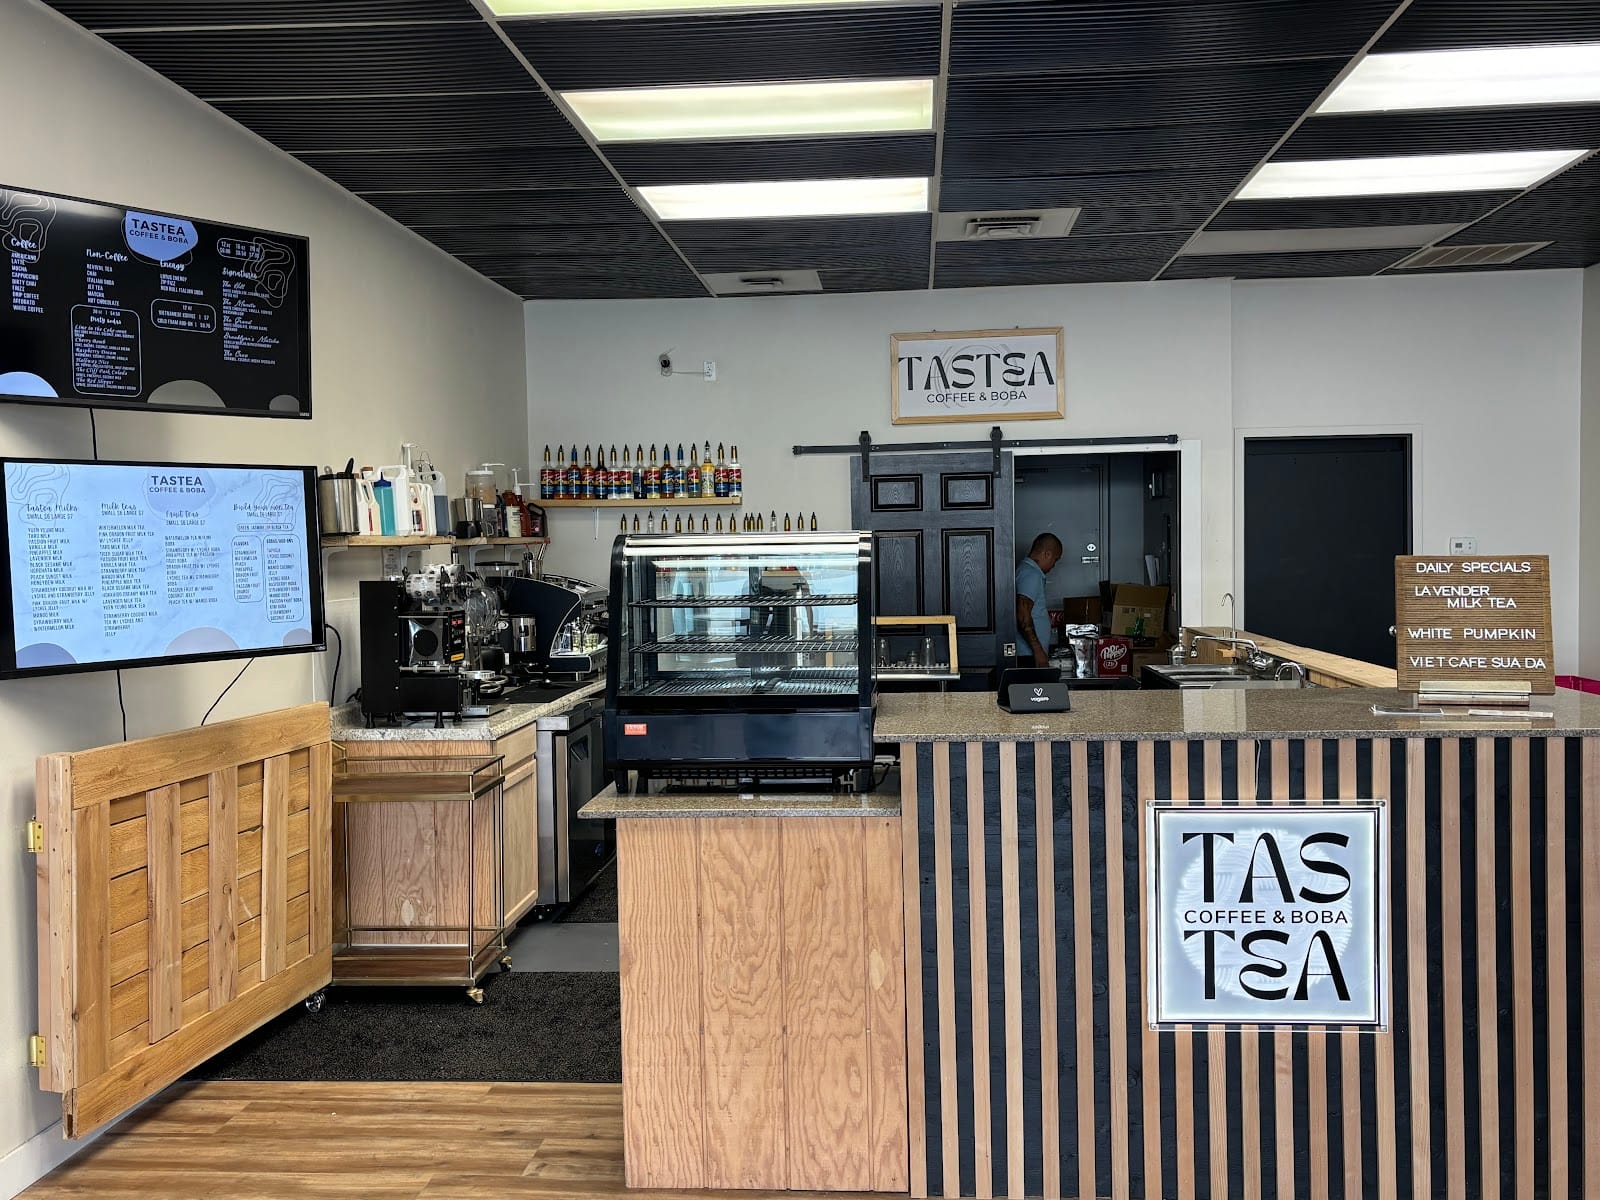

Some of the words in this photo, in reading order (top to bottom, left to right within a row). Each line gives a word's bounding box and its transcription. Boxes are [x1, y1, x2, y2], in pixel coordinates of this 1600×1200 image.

[132, 218, 186, 236] TASTEA
[130, 229, 158, 240] COFFEE
[168, 236, 188, 244] BOBA
[11, 238, 37, 249] Coffee
[898, 352, 1054, 390] TASTEA
[926, 392, 975, 403] COFFEE
[979, 392, 987, 401] &
[991, 390, 1027, 400] BOBA
[151, 475, 202, 486] TASTEA
[1416, 563, 1453, 573] DAILY
[1462, 562, 1531, 572] SPECIALS
[1448, 598, 1482, 608] MILK
[1487, 598, 1516, 608] TEA
[1408, 628, 1452, 639] WHITE
[1464, 629, 1536, 640] PUMPKIN
[1449, 657, 1487, 668] CAFE
[1492, 658, 1520, 668] SUA
[1525, 658, 1546, 668] DA
[1182, 832, 1350, 904] TAS
[1184, 910, 1266, 924] COFFEE
[1272, 910, 1285, 924] &
[1292, 910, 1348, 924] BOBA
[1184, 930, 1351, 1001] TEA
